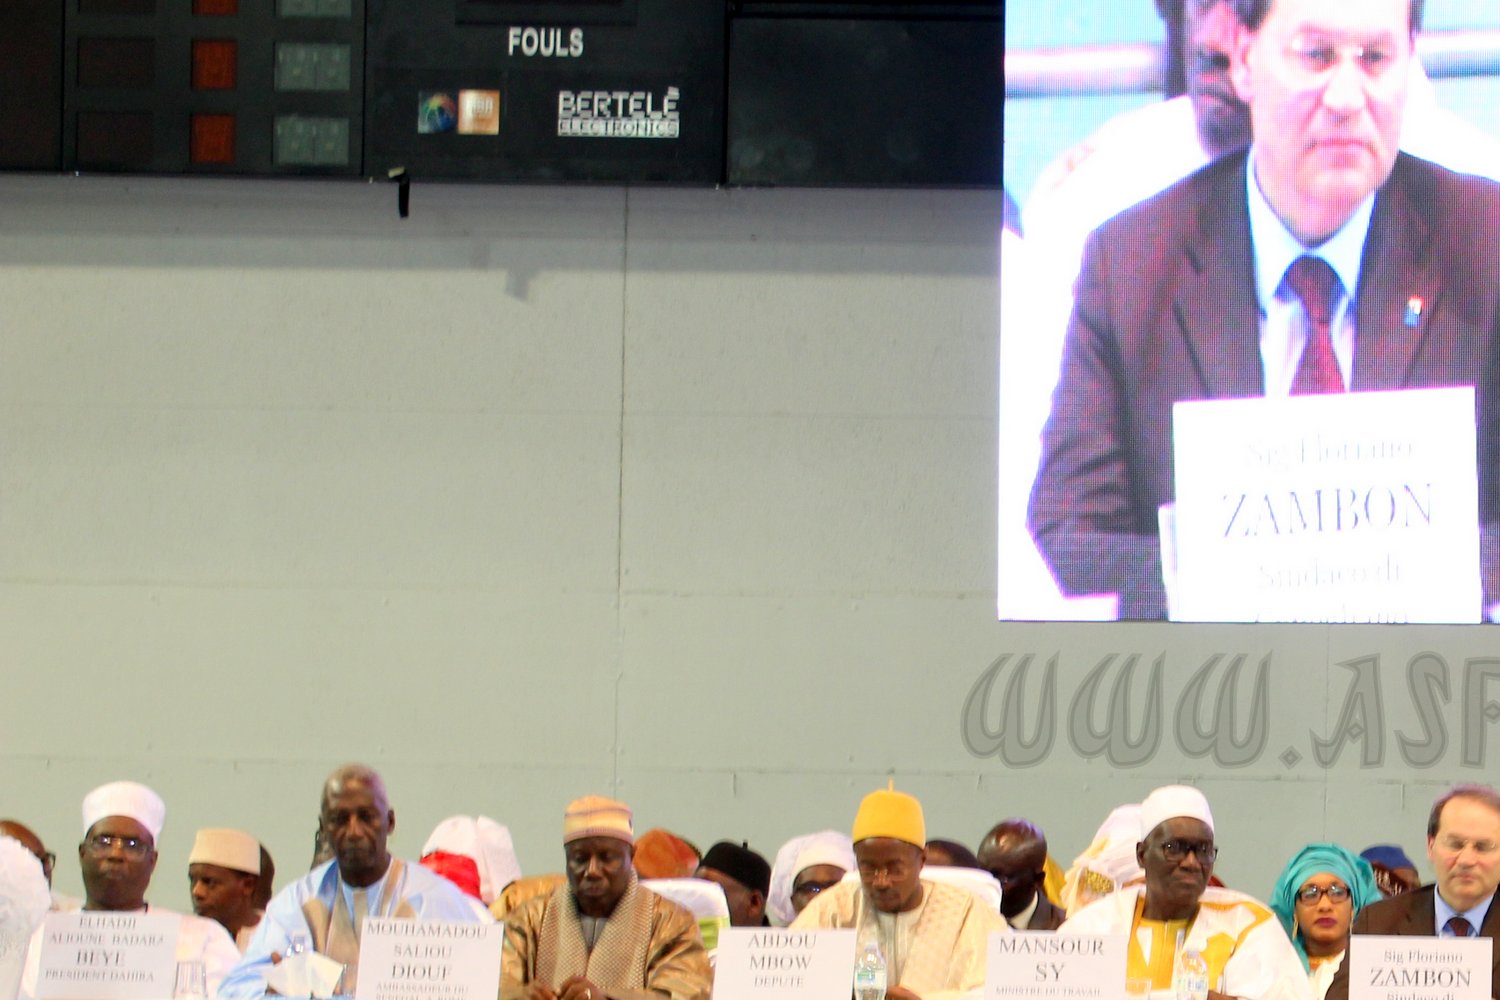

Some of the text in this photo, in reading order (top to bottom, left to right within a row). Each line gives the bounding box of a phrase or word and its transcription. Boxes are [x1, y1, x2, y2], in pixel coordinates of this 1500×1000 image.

[508, 26, 584, 57] FOULS
[557, 117, 680, 138] ELECTRONICS
[1221, 482, 1434, 540] ZAMBON
[367, 921, 488, 939] MOUHAMADOU
[747, 932, 818, 950] ABDOU
[999, 936, 1104, 956] MANSOUR
[76, 949, 126, 967] BEYE
[394, 945, 453, 959] SALIOU
[1384, 950, 1463, 965] Sig Floriano
[749, 953, 811, 971] MBOW
[391, 963, 453, 981] DIOUF
[1035, 962, 1065, 982] SY
[1369, 967, 1472, 988] ZAMBON
